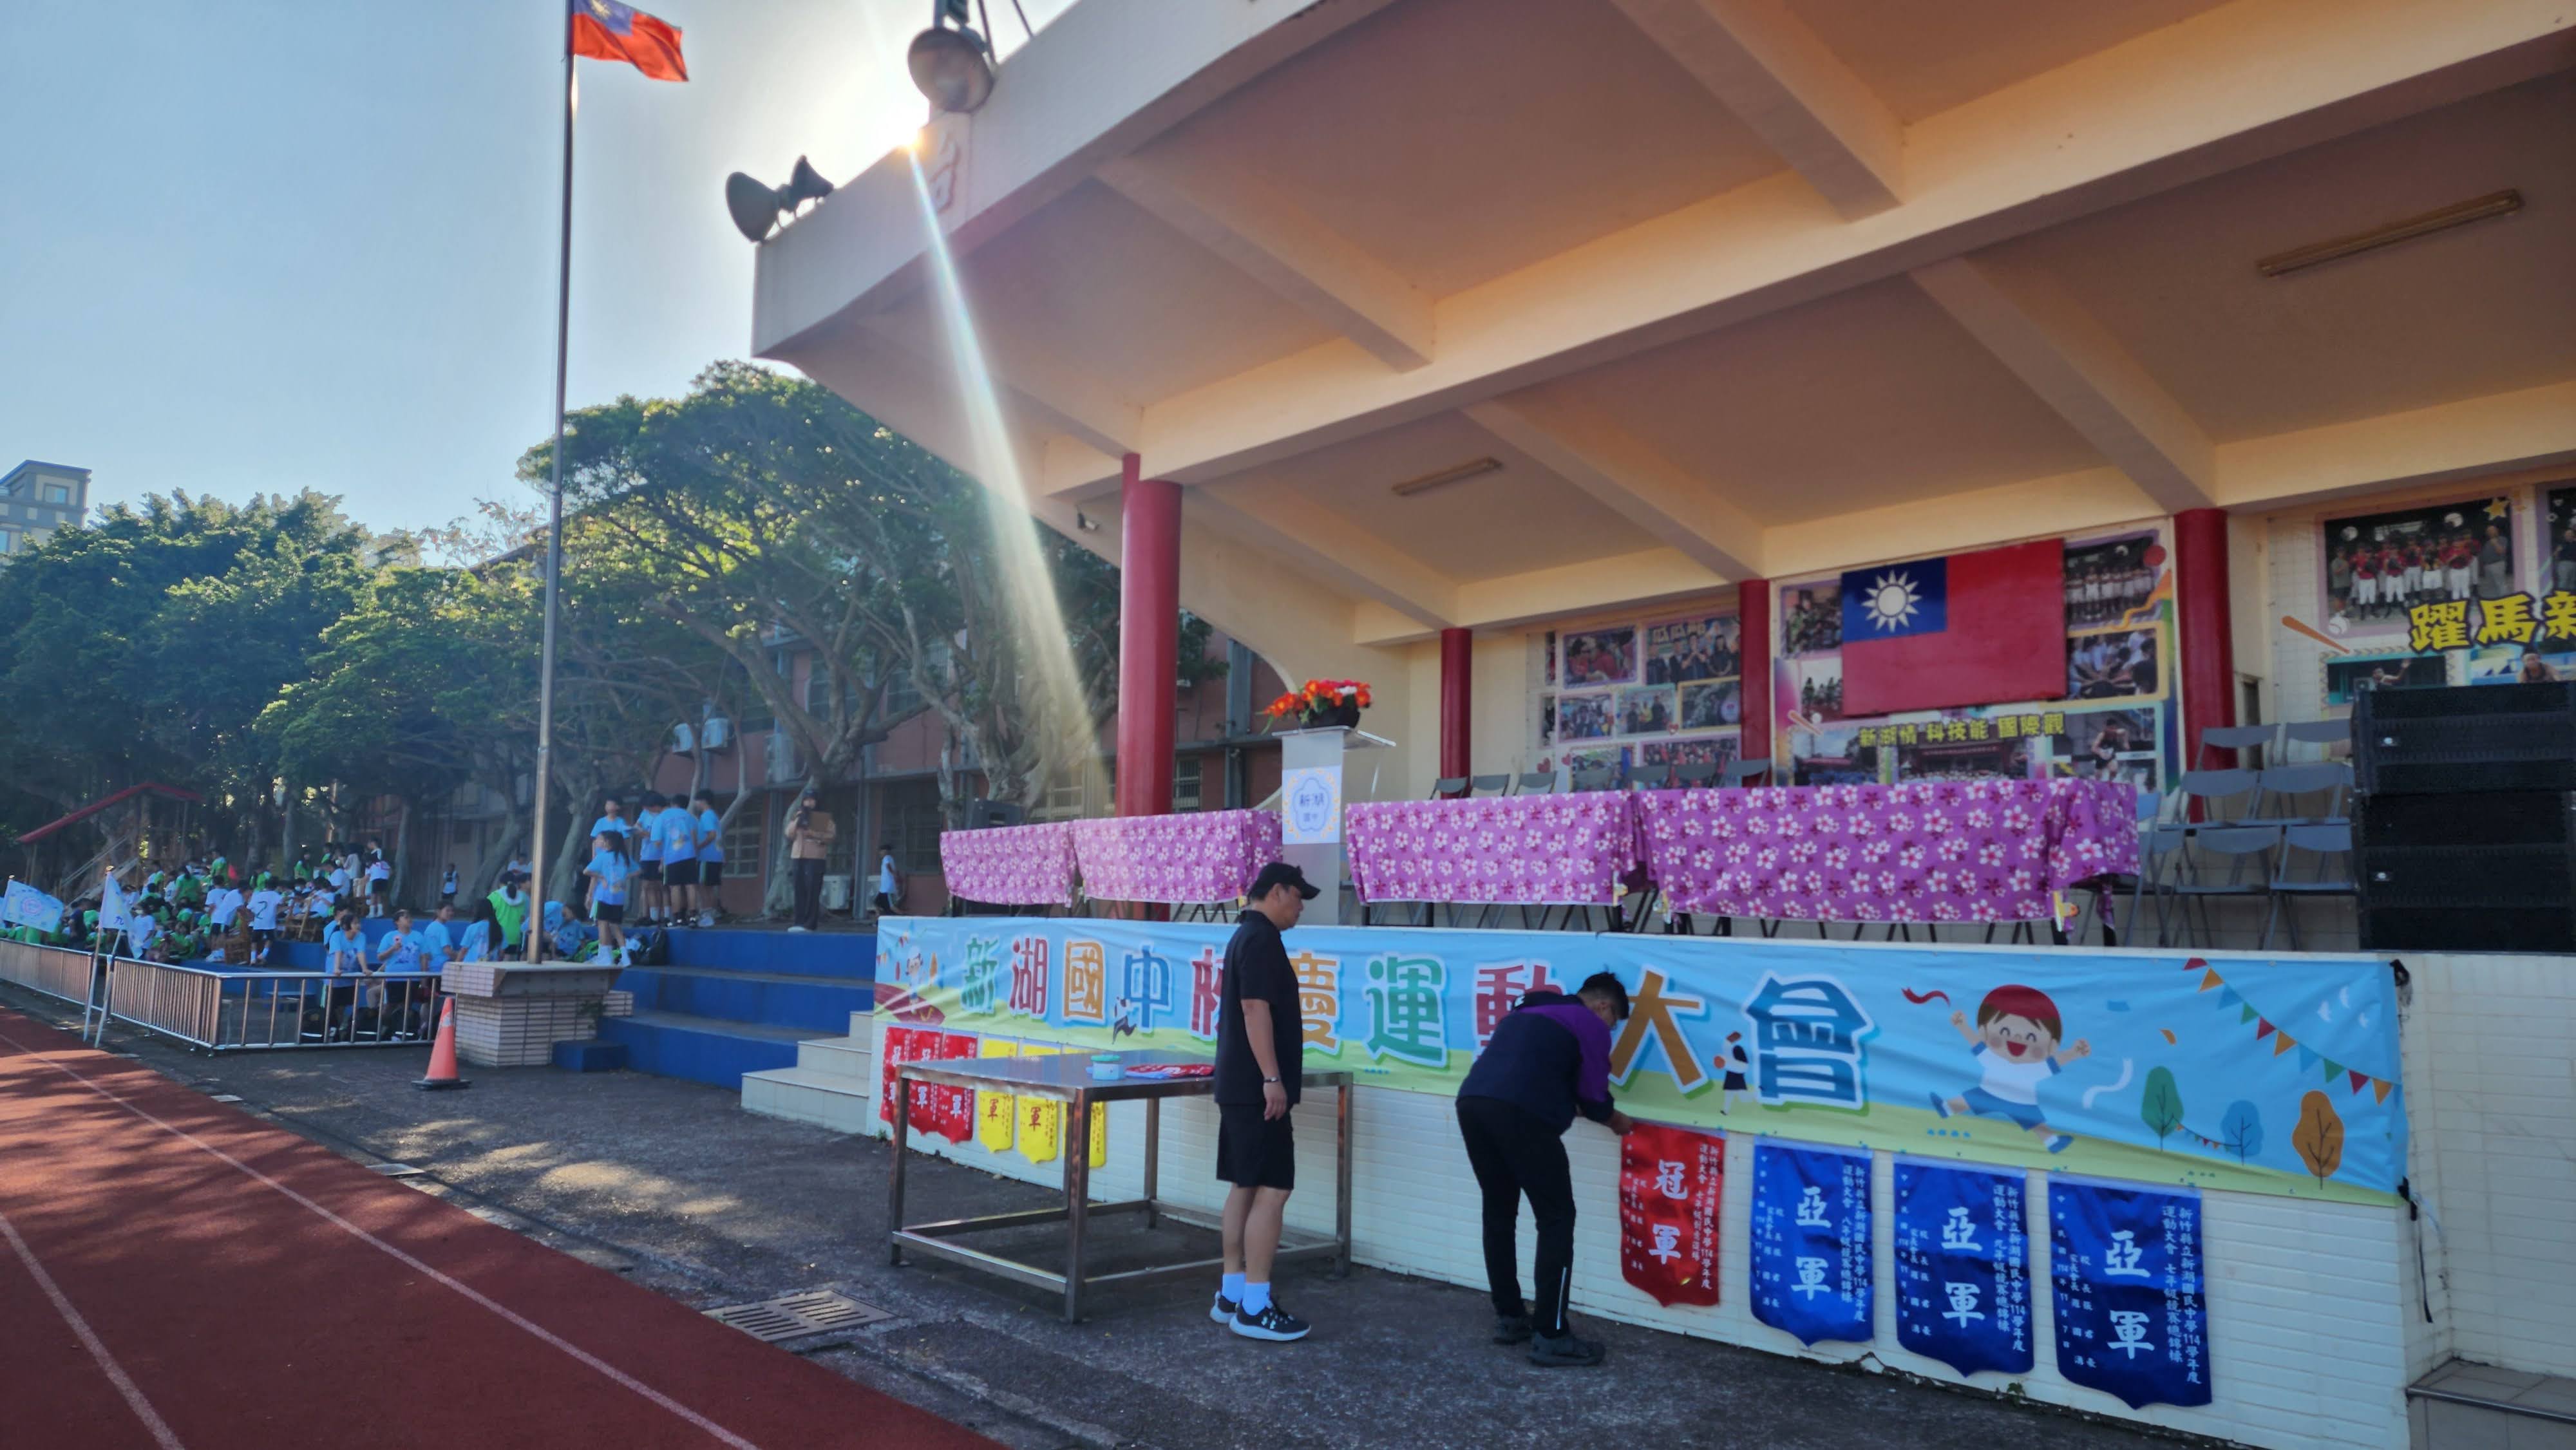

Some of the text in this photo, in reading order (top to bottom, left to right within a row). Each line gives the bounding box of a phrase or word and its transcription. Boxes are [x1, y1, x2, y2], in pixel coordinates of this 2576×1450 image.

[257, 901, 268, 919] 2
[1649, 1159, 1688, 1265] 冠軍
[1790, 1186, 1832, 1301] 亞軍
[1941, 1207, 1985, 1328] 亞軍
[2104, 1230, 2155, 1360] 亞軍
